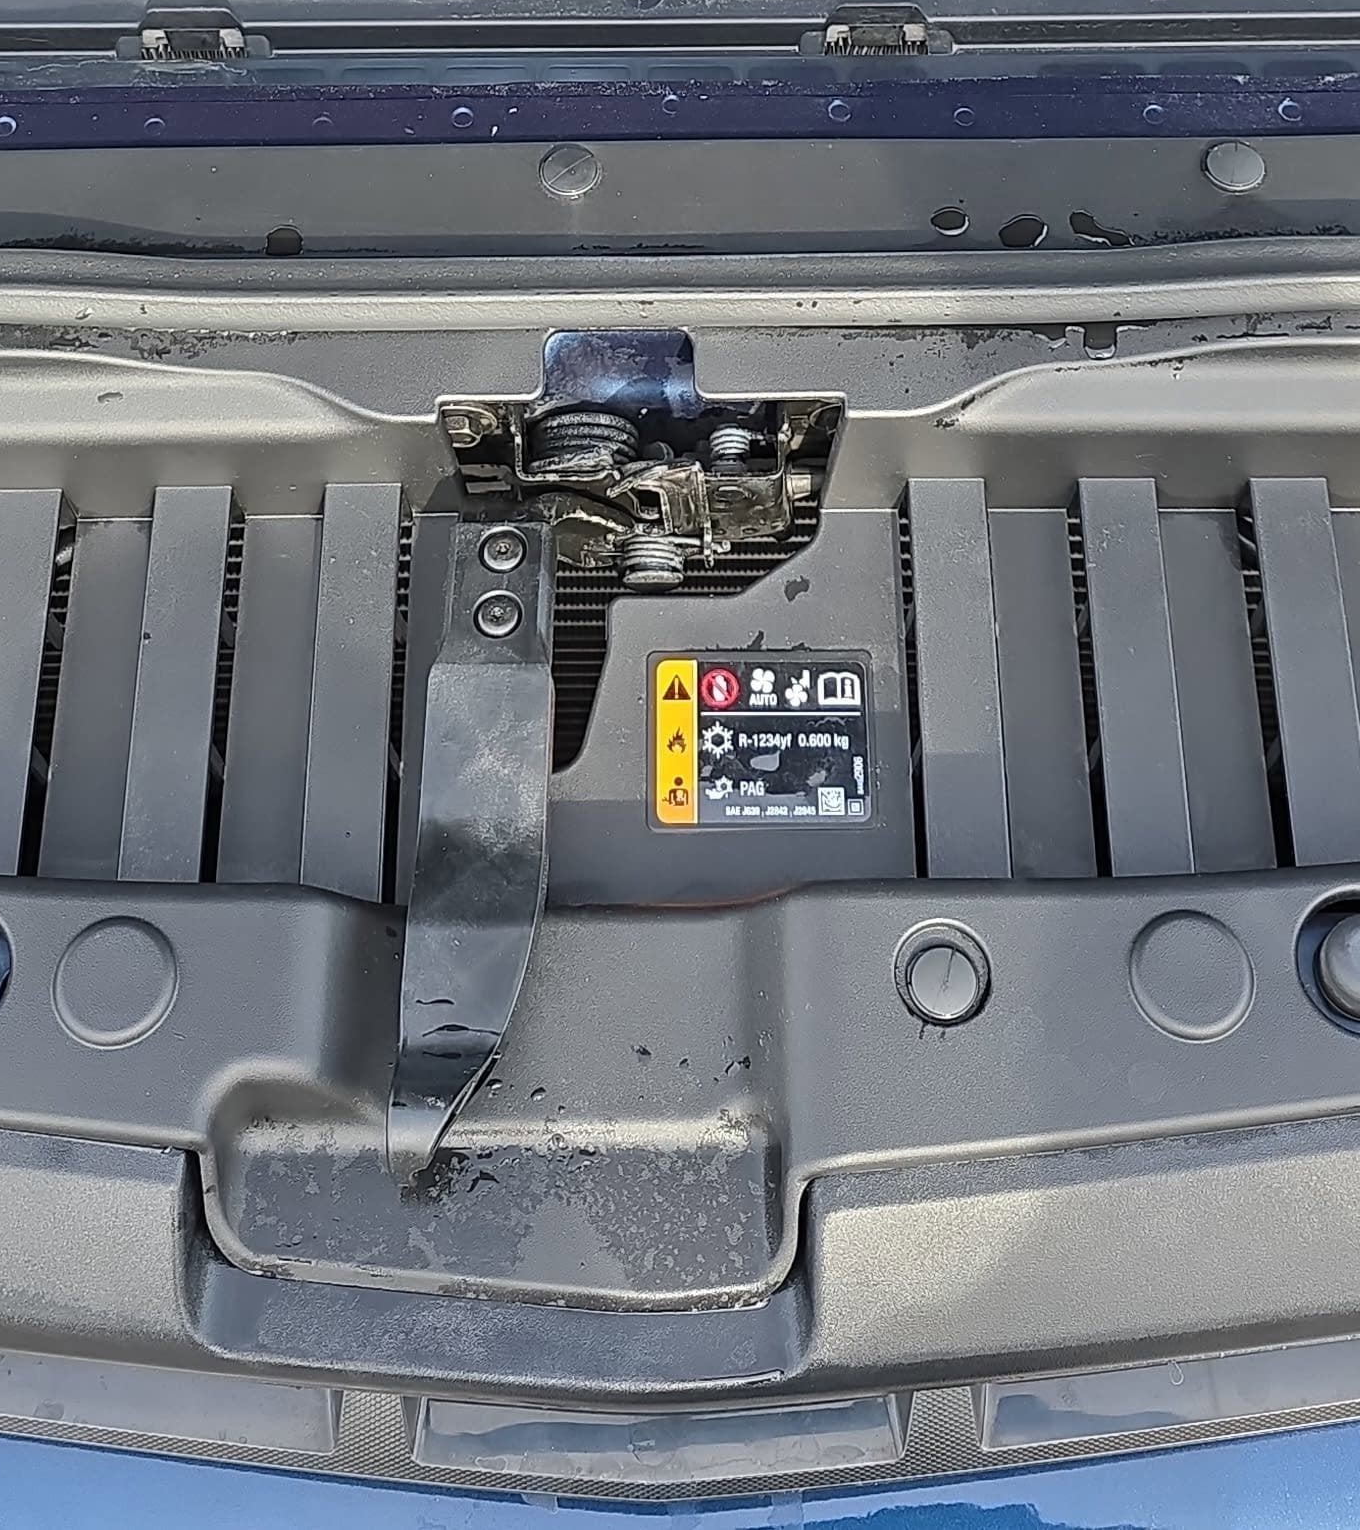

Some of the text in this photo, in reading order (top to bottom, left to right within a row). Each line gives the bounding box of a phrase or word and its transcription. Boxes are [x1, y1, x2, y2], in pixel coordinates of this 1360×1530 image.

[749, 693, 777, 706] AUTO
[738, 732, 849, 749] R-1234yf 0.600 kg
[740, 781, 765, 796] PAG
